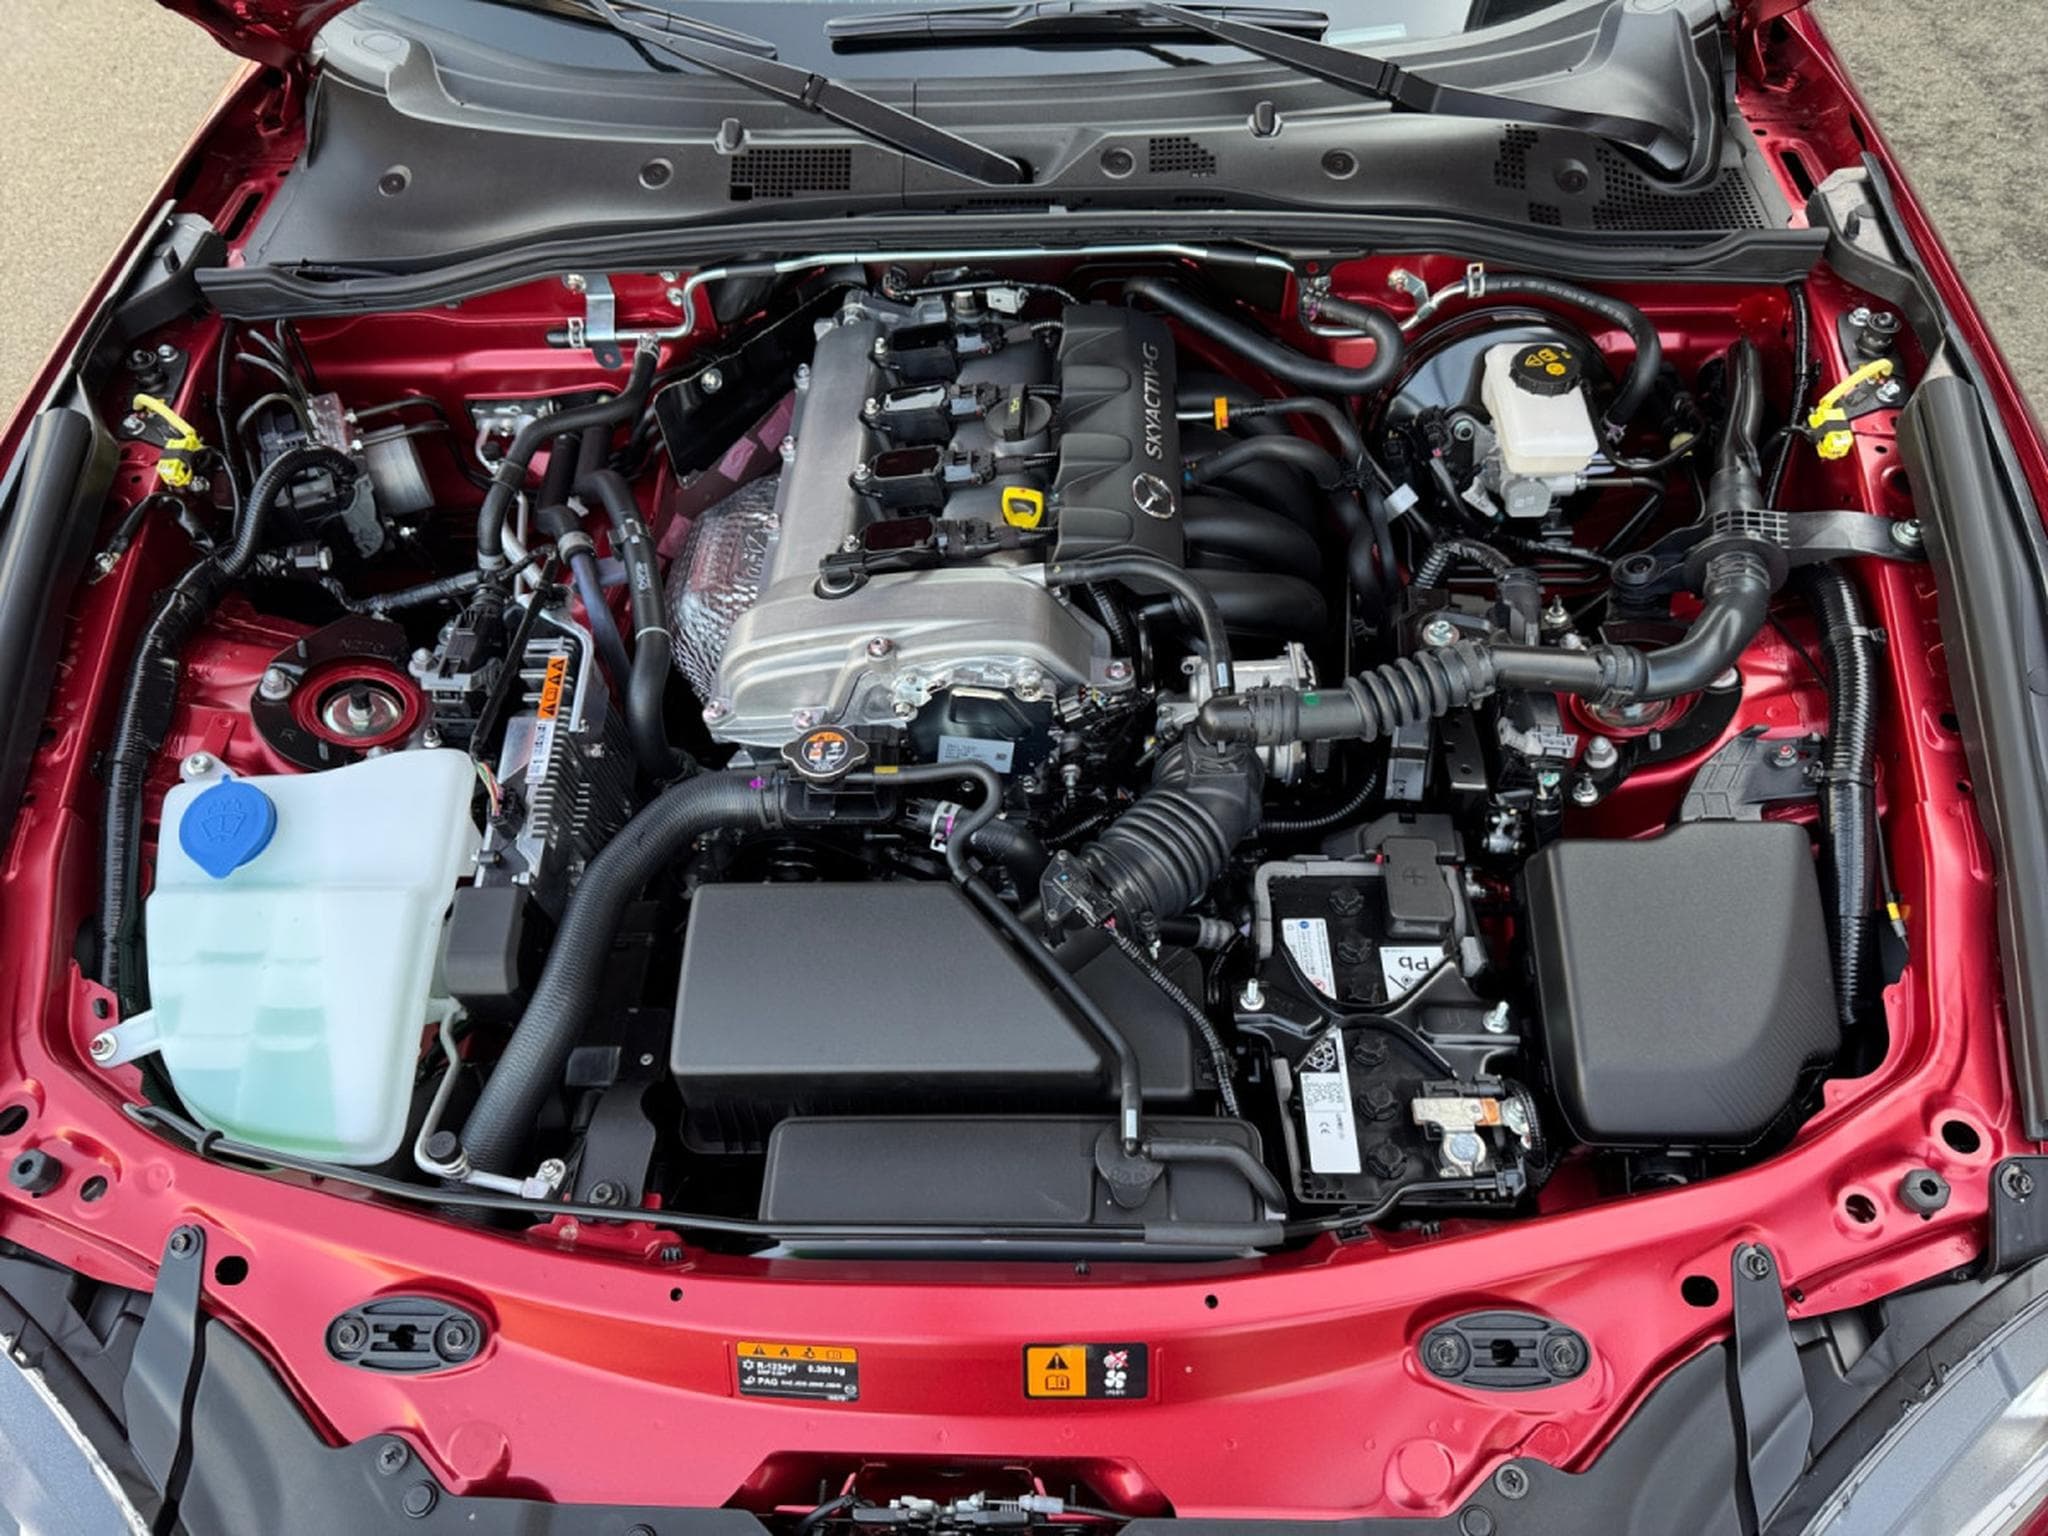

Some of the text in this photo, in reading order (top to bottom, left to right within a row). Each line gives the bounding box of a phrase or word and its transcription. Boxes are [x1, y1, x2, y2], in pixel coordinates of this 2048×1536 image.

[1142, 342, 1162, 460] SKYACTIV-G
[1398, 956, 1429, 971] Pb
[833, 1365, 846, 1377] kg
[757, 1376, 778, 1387] PAG
